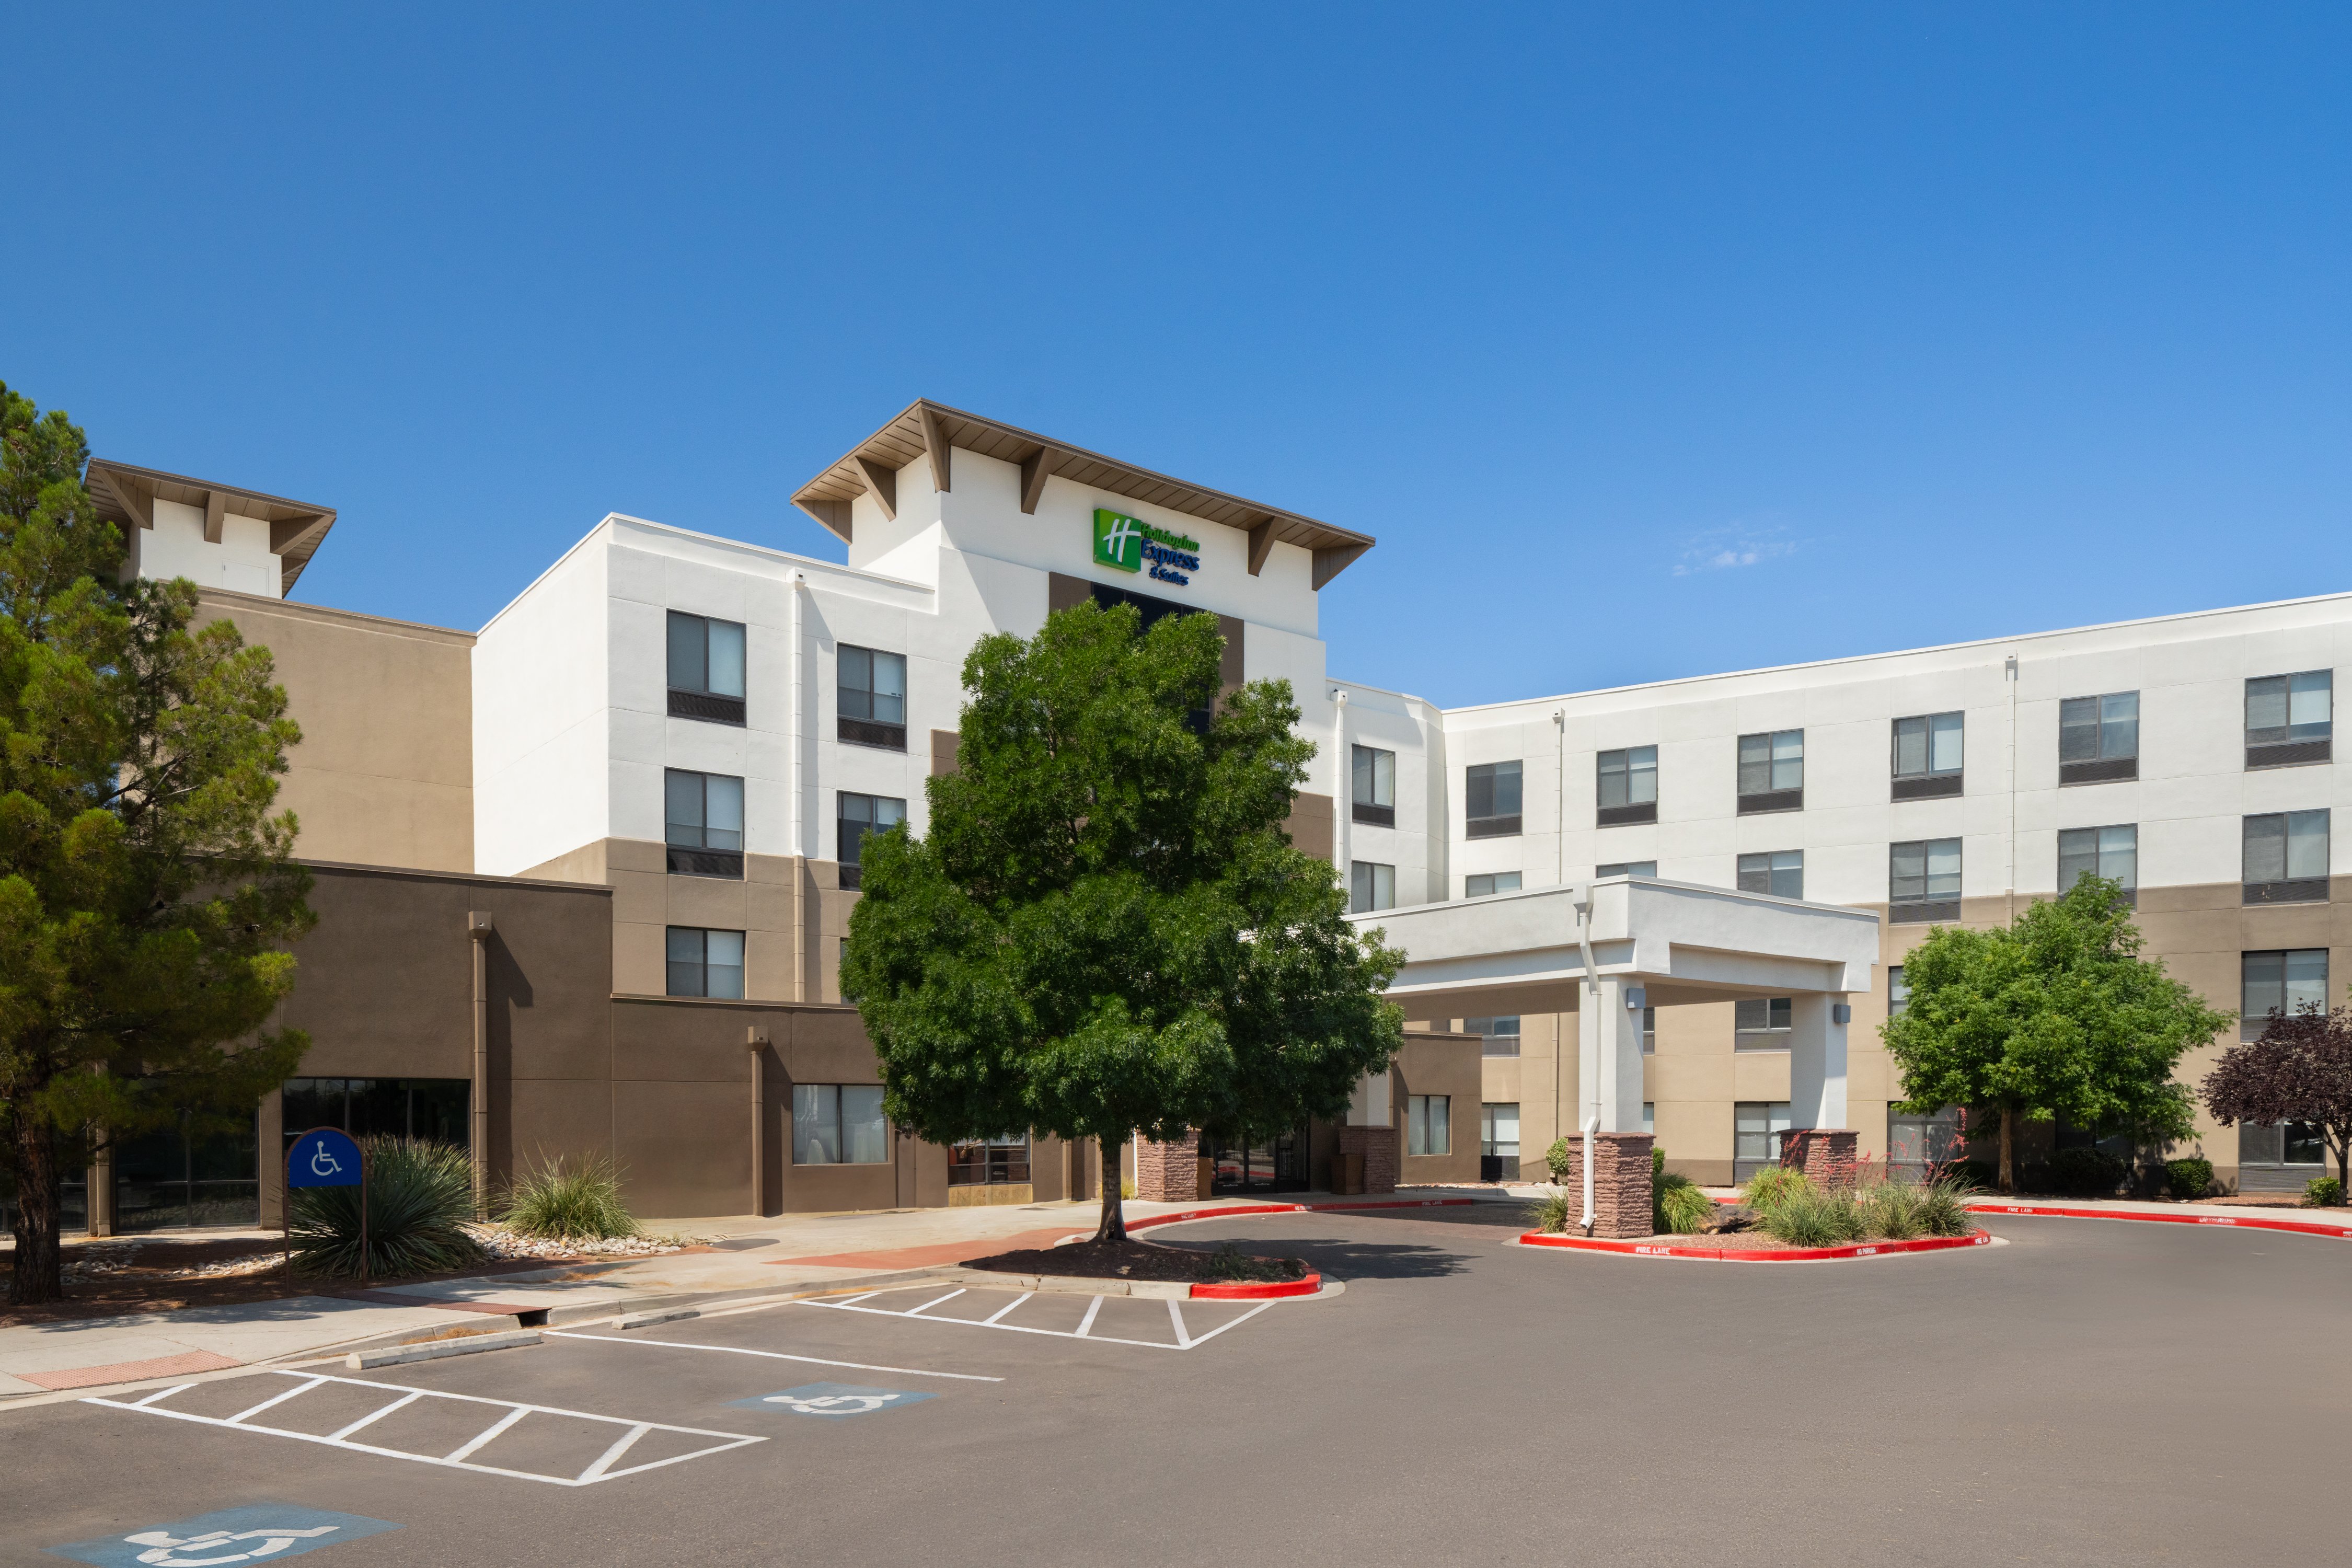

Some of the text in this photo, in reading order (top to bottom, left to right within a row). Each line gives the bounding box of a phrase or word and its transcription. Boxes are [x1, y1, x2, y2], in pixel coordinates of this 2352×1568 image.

[1140, 523, 1200, 552] Holiday Inn
[1140, 538, 1200, 572] Express
[1149, 566, 1189, 586] & Suites
